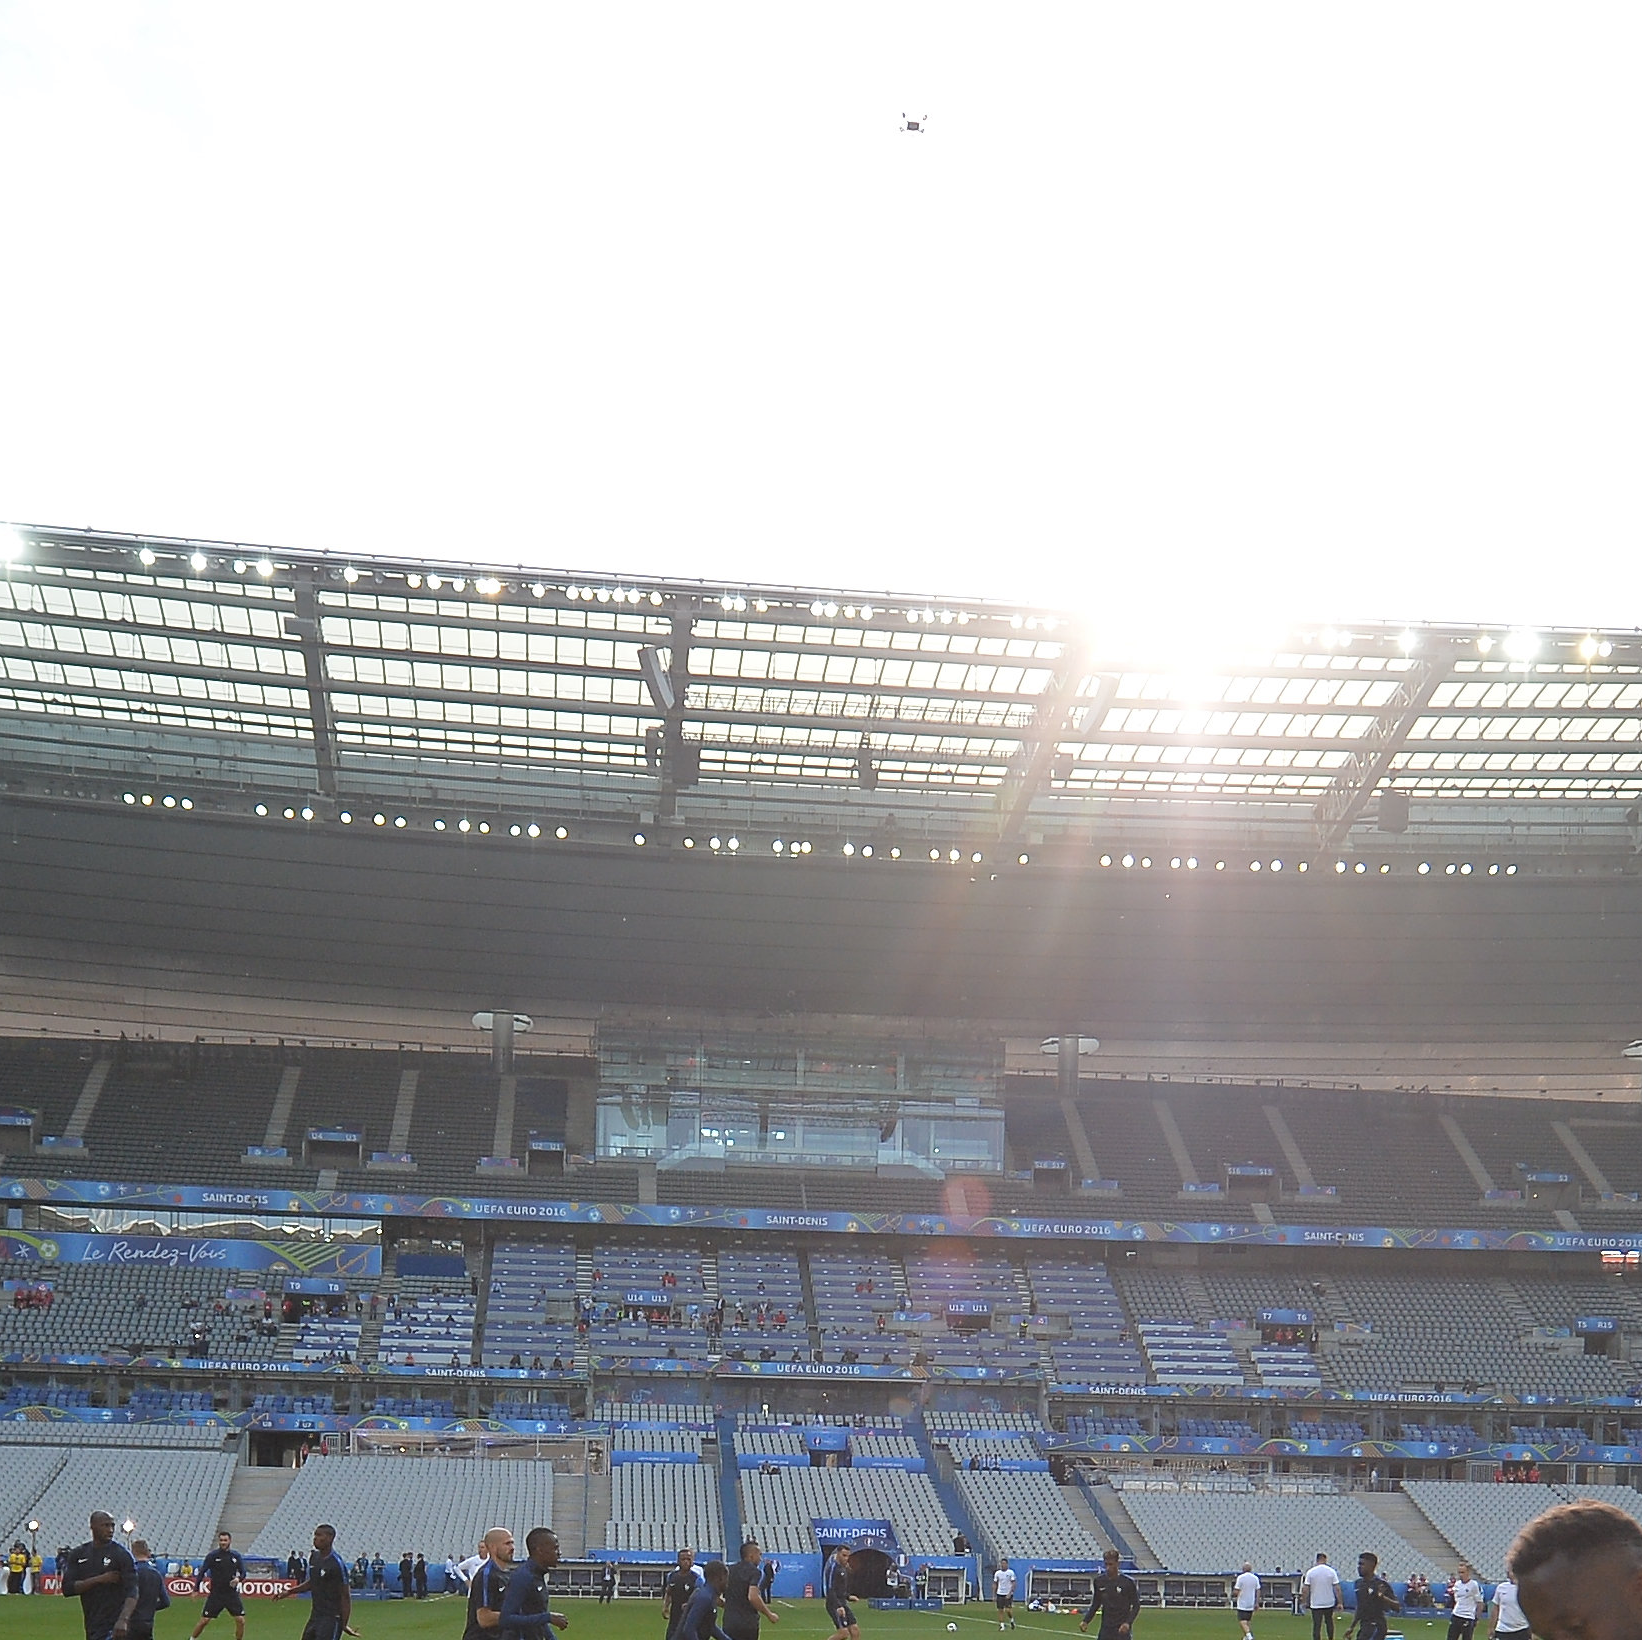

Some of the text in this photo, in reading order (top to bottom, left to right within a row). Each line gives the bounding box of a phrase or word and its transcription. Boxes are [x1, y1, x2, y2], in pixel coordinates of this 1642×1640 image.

[311, 1131, 324, 1140] U4
[202, 1192, 269, 1205] SAINT-DEIS
[474, 1204, 567, 1217] UEFA EURO 2016
[766, 1215, 828, 1226] SAINT-DENIS
[1023, 1223, 1111, 1235] UEFA EURO 2016
[1304, 1231, 1365, 1242] SAINT-DNIS
[1557, 1236, 1586, 1247] UEFA
[1588, 1237, 1616, 1248] EURO
[83, 1241, 228, 1267] Le Rendez-Vous
[627, 1293, 668, 1303] U14 U13
[949, 1304, 989, 1312] U12 U11
[1262, 1312, 1272, 1320] T7
[199, 1361, 290, 1372] UEFA EURO 2016
[777, 1363, 860, 1375] UEFA EURO 2016
[425, 1368, 486, 1378] SAINT-DENIS
[1089, 1386, 1147, 1396] SAINT-DENIS
[1369, 1393, 1452, 1403] UEFA EURO 2016
[815, 1527, 888, 1540] SAINT-DENIS
[173, 1582, 192, 1593] KIA
